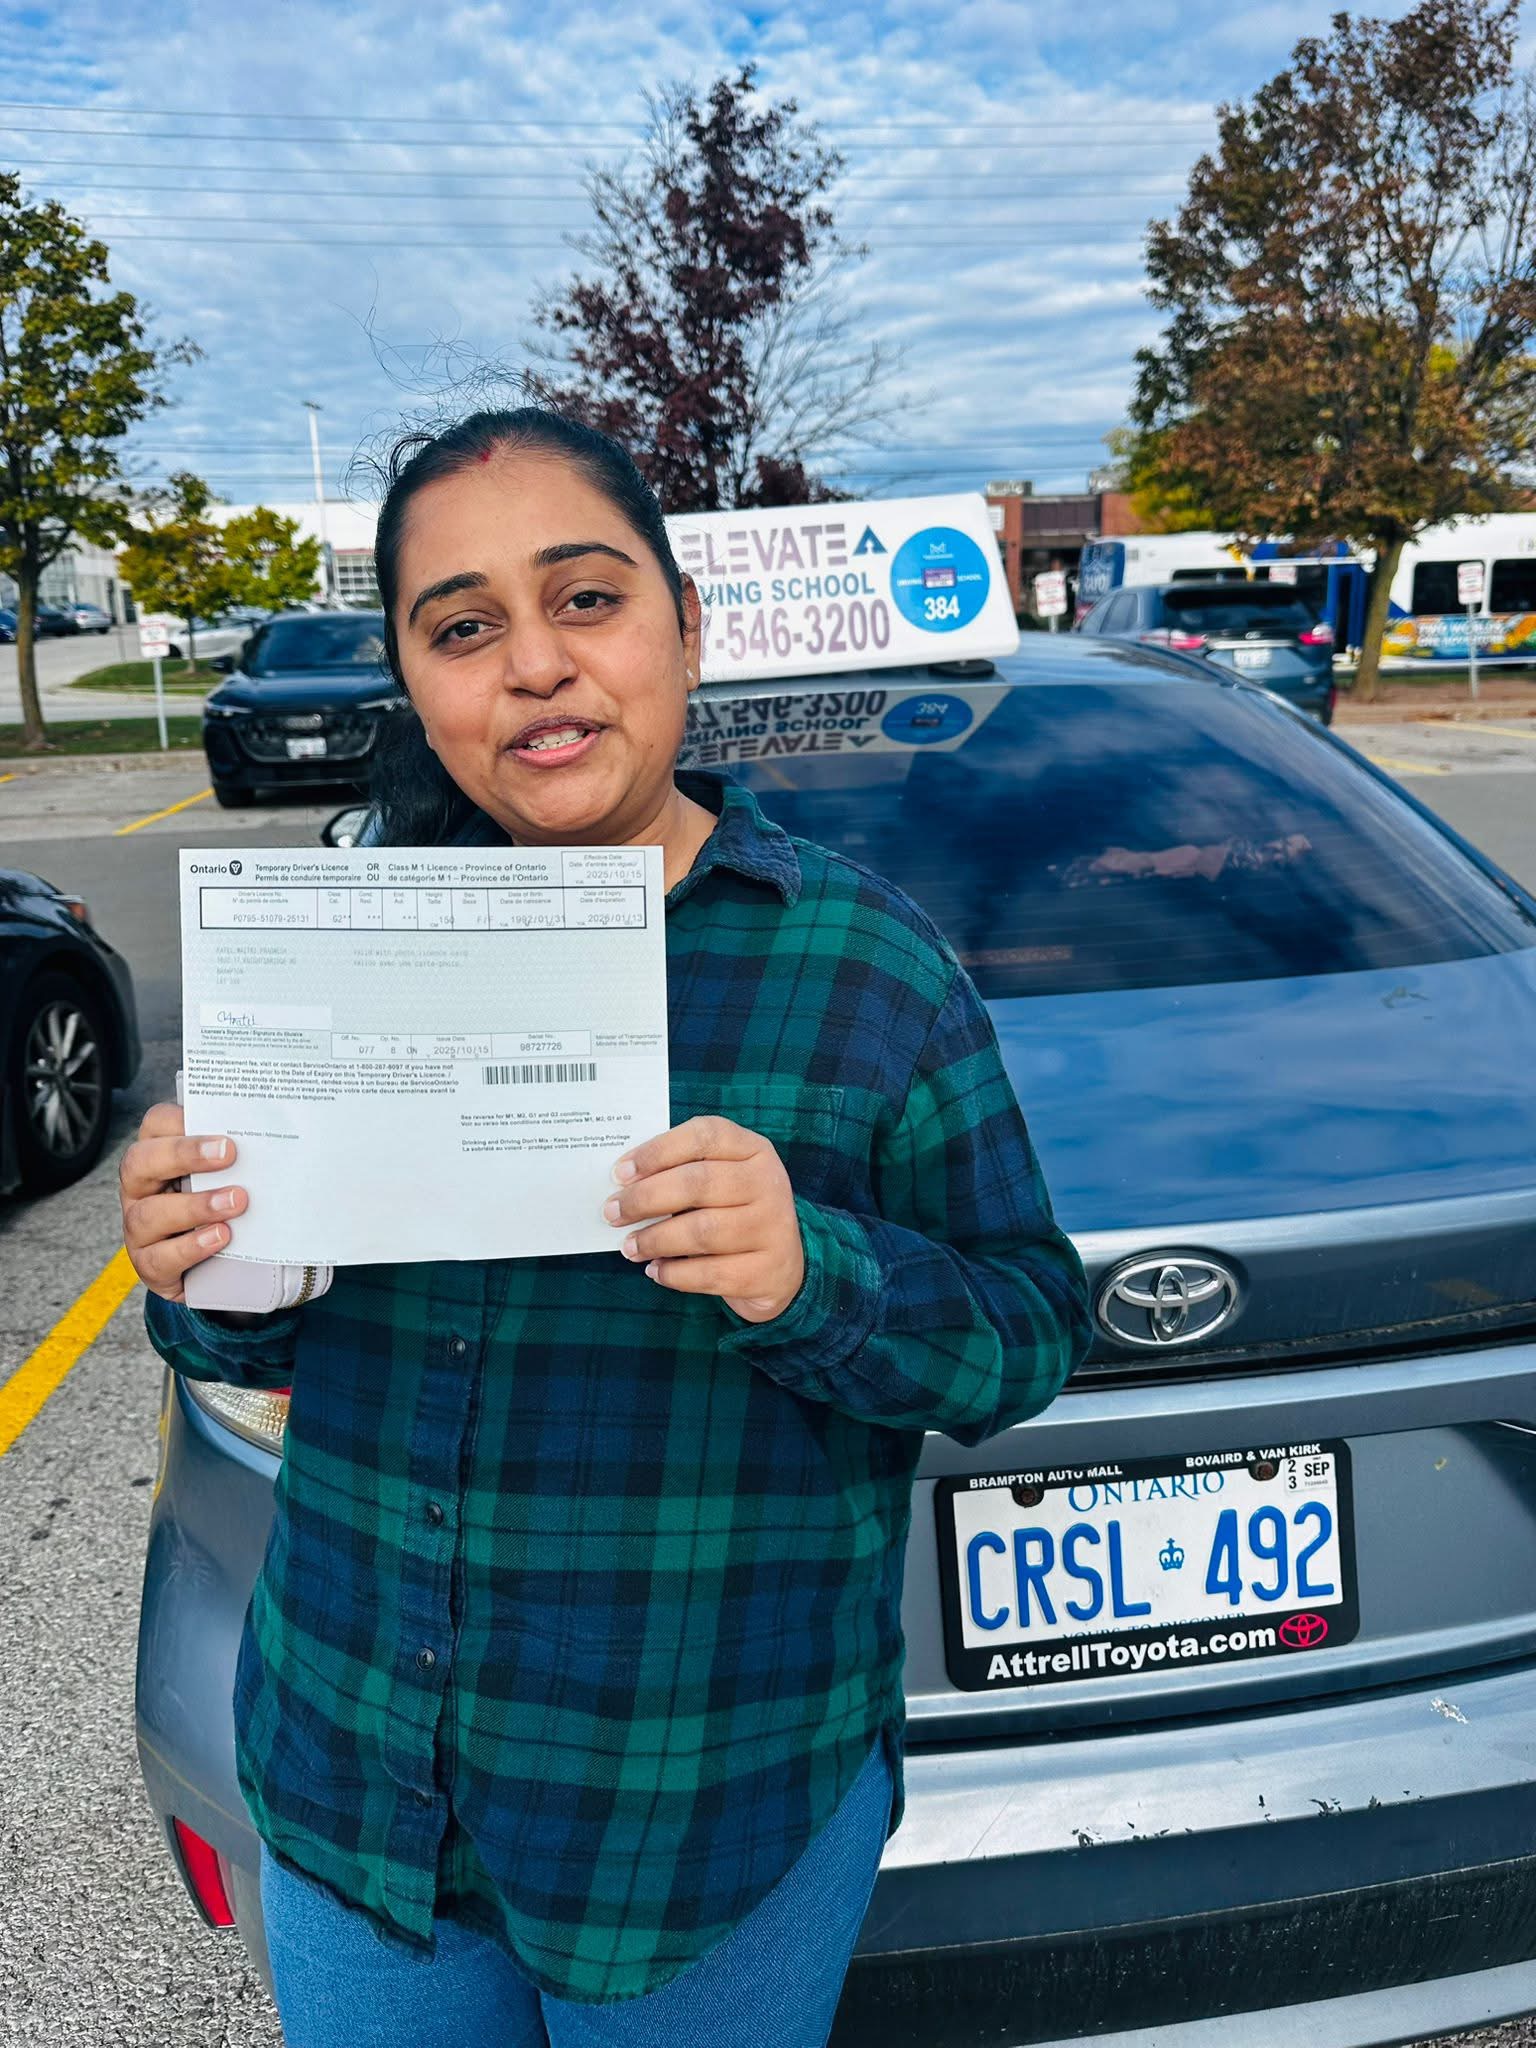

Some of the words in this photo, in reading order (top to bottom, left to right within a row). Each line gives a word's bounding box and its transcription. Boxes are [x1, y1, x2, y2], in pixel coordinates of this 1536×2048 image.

[680, 523, 847, 576] ELEVATE
[772, 571, 875, 602] SCHOOL
[924, 595, 960, 621] 384
[190, 864, 227, 874] Ontario
[256, 864, 291, 872] Temporary
[367, 863, 380, 871] OR
[367, 874, 380, 882] OU
[400, 874, 436, 883] catégorie
[1186, 1452, 1243, 1468] BOVAIRD
[1246, 1451, 1256, 1461] &
[1259, 1447, 1286, 1460] VAN
[1289, 1443, 1322, 1456] KIRK
[969, 1472, 1044, 1489] BRAMPTON
[1087, 1465, 1123, 1478] MALL
[1304, 1462, 1330, 1478] SEP
[1068, 1471, 1225, 1512] ONTARIO
[967, 1520, 1151, 1630] CRSL
[1205, 1501, 1335, 1606] 492
[987, 1624, 1276, 1681] AttrellToyota.com
